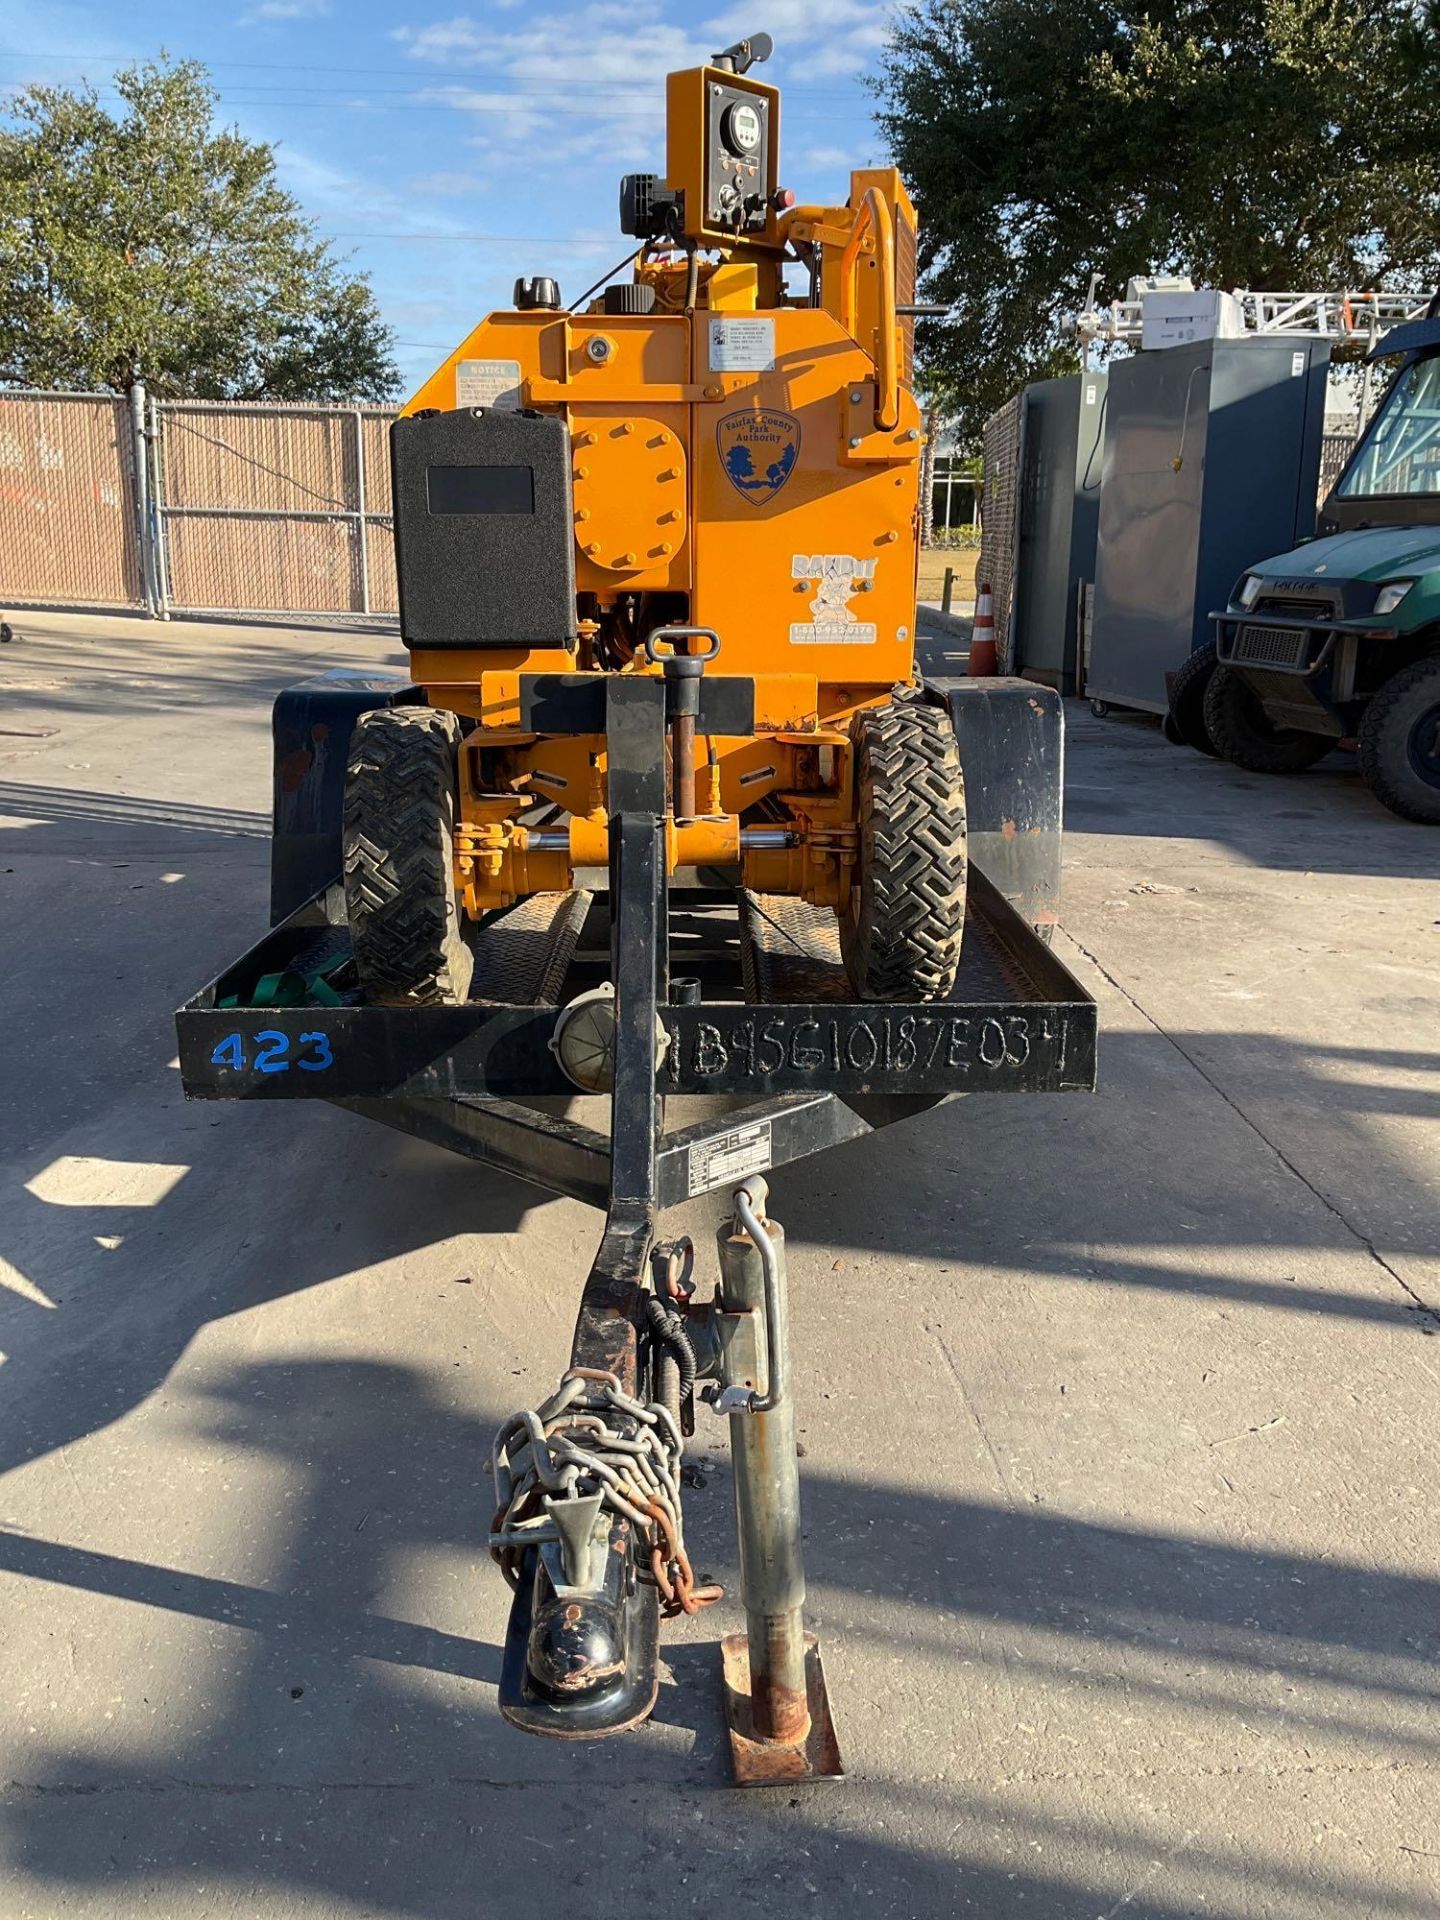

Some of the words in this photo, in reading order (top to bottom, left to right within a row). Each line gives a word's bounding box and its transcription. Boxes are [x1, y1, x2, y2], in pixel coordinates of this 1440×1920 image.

[471, 365, 506, 376] NOTICE
[725, 415, 757, 431] Fairfax
[761, 415, 793, 434] County
[749, 424, 769, 433] Park
[736, 433, 782, 444] Authority
[210, 1030, 334, 1073] 423
